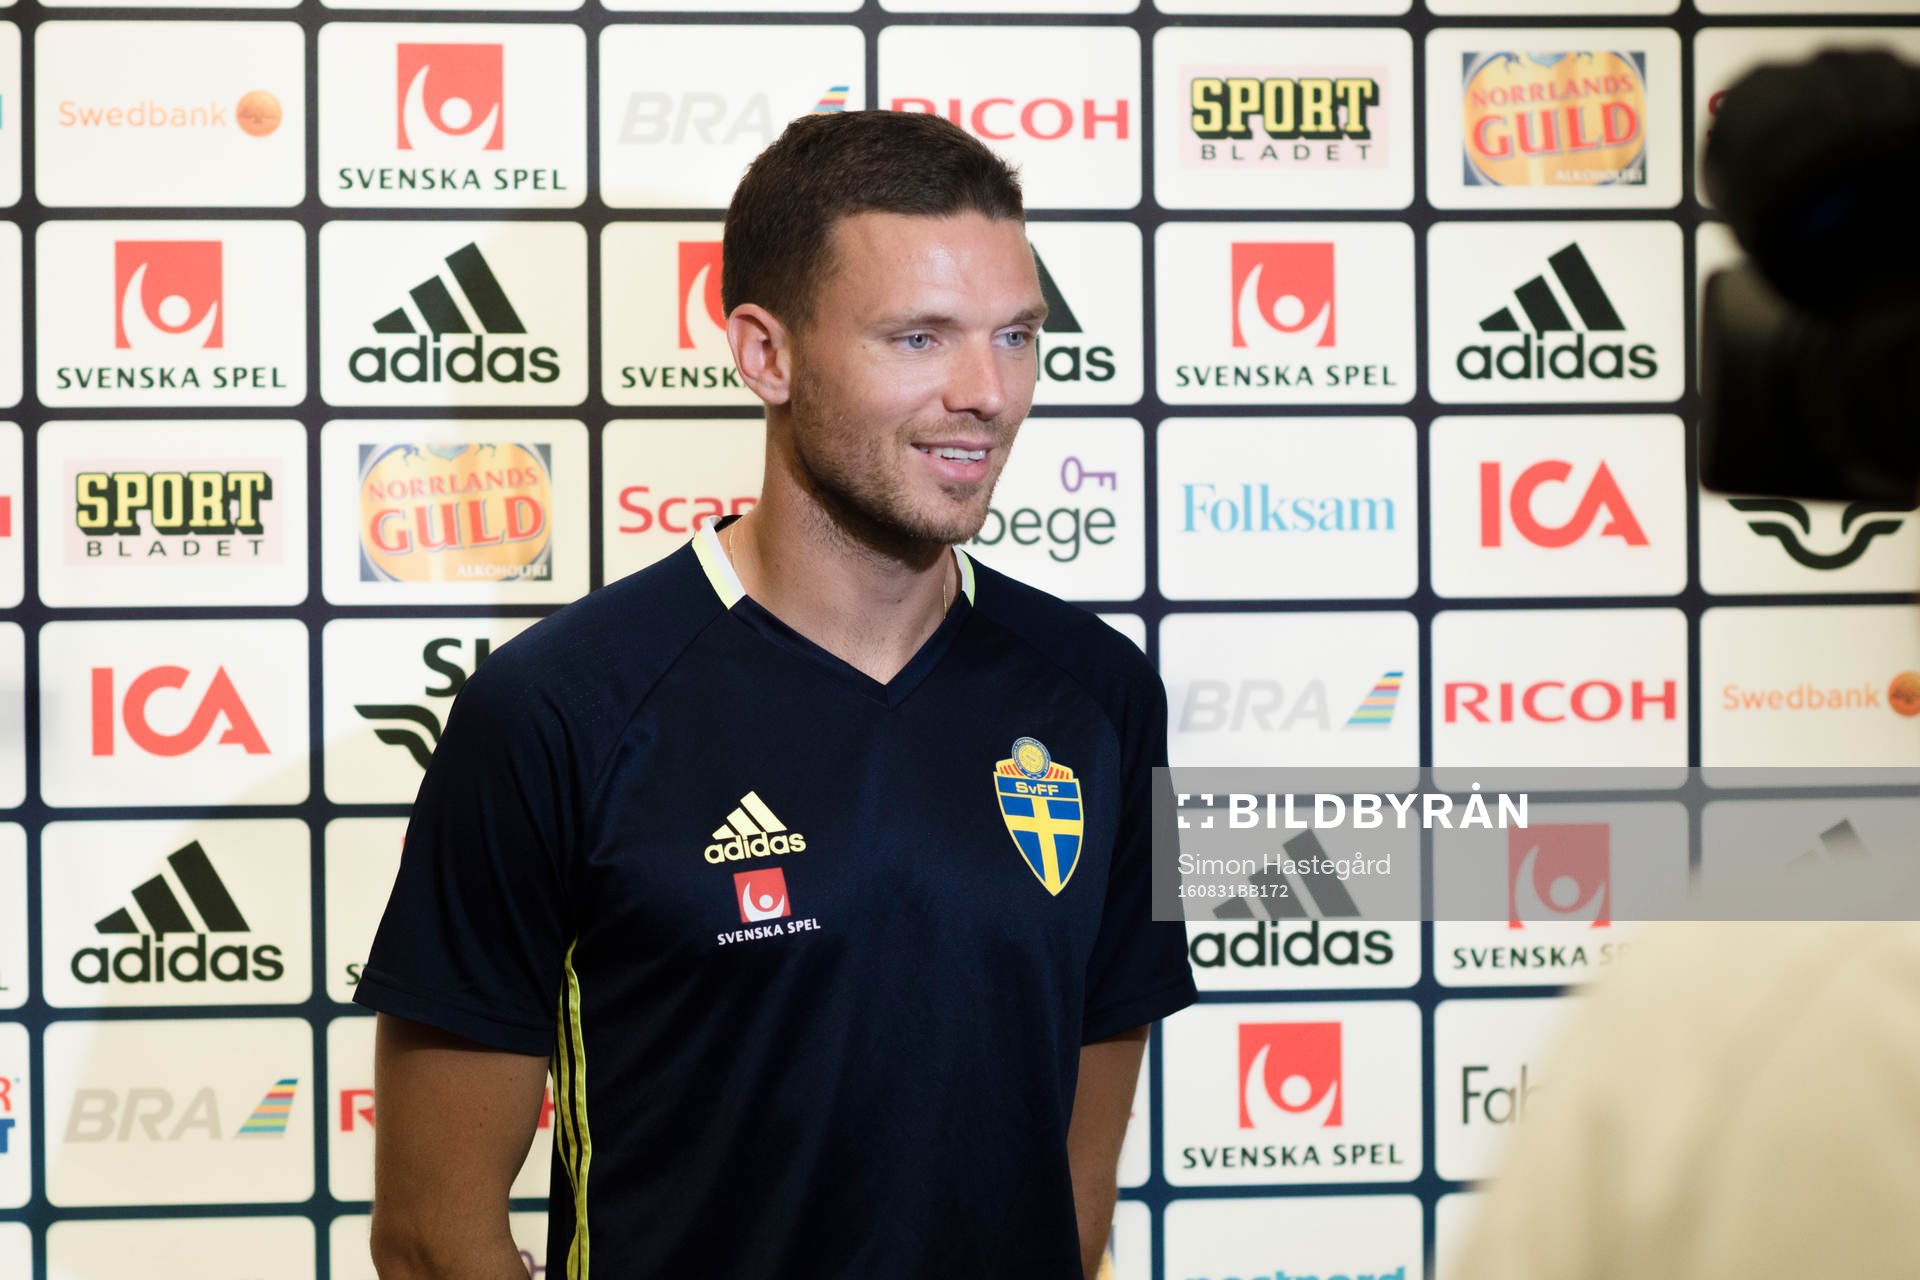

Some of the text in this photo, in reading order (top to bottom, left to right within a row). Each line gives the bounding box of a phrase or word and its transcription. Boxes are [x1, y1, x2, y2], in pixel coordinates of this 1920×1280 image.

[1191, 77, 1380, 140] SPORT
[1470, 74, 1634, 108] NORRLANDS
[57, 99, 228, 128] Swedbank
[616, 91, 775, 145] BRA
[1472, 100, 1641, 160] GULD
[1201, 144, 1372, 162] BLADET
[339, 168, 568, 190] SVENSKA SPEL
[349, 334, 561, 384] adidas
[1176, 365, 1396, 387] SVENSKA SPEL
[1456, 333, 1658, 380] adidas
[56, 367, 287, 389] SVENSKA SPEL
[622, 366, 750, 388] SVENSK
[76, 471, 272, 536] SPORT
[369, 465, 540, 502] NORRLANDS
[1181, 483, 1395, 533] Folksam
[1480, 460, 1650, 549] ICA
[369, 494, 547, 556] GULD
[87, 540, 264, 557] BLADET
[91, 665, 271, 757] ICA
[1178, 680, 1331, 733] BRA
[1444, 680, 1677, 723] RICOH
[1722, 684, 1882, 711] Swedbank
[1015, 782, 1059, 796] SvFF
[704, 832, 807, 864] adidas
[717, 918, 821, 946] SVENSKA SPEL
[1189, 920, 1394, 968] adidas
[71, 933, 284, 984] adidas
[1453, 947, 1588, 969] SVENSKA
[62, 1086, 223, 1143] BRA
[1182, 1144, 1404, 1169] SVENSKA SPEL
